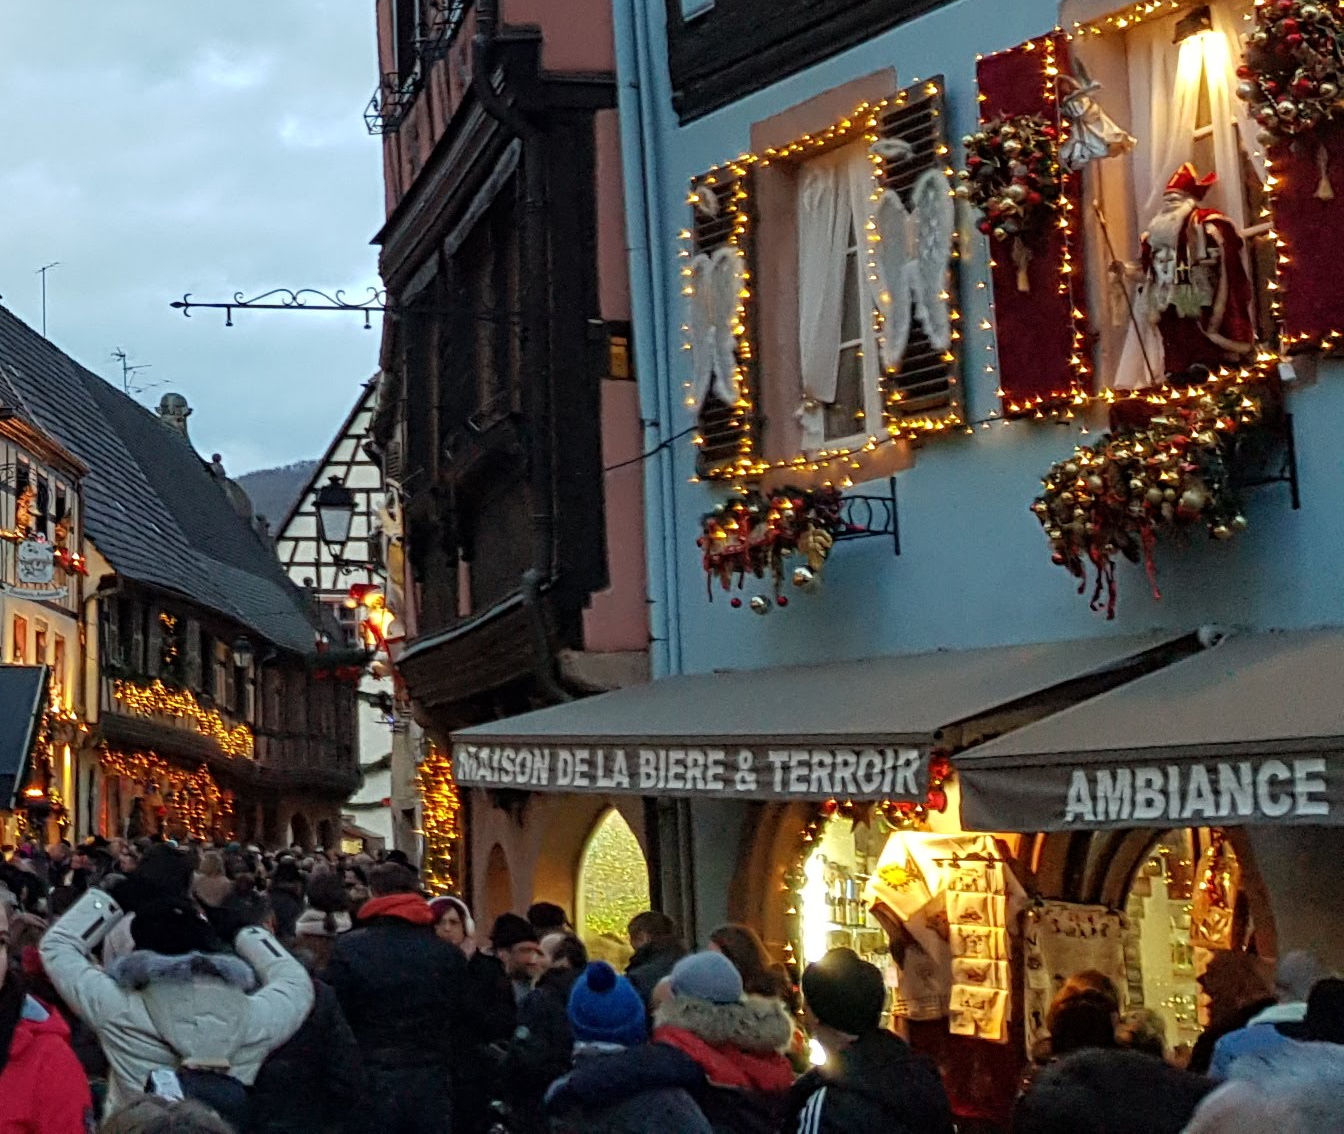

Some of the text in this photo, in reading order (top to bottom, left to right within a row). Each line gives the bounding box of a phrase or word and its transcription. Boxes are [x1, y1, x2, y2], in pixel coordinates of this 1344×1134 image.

[457, 746, 920, 795] MAISON DE LA BIERE & TERROIR
[1064, 759, 1330, 822] AMBIANCE
